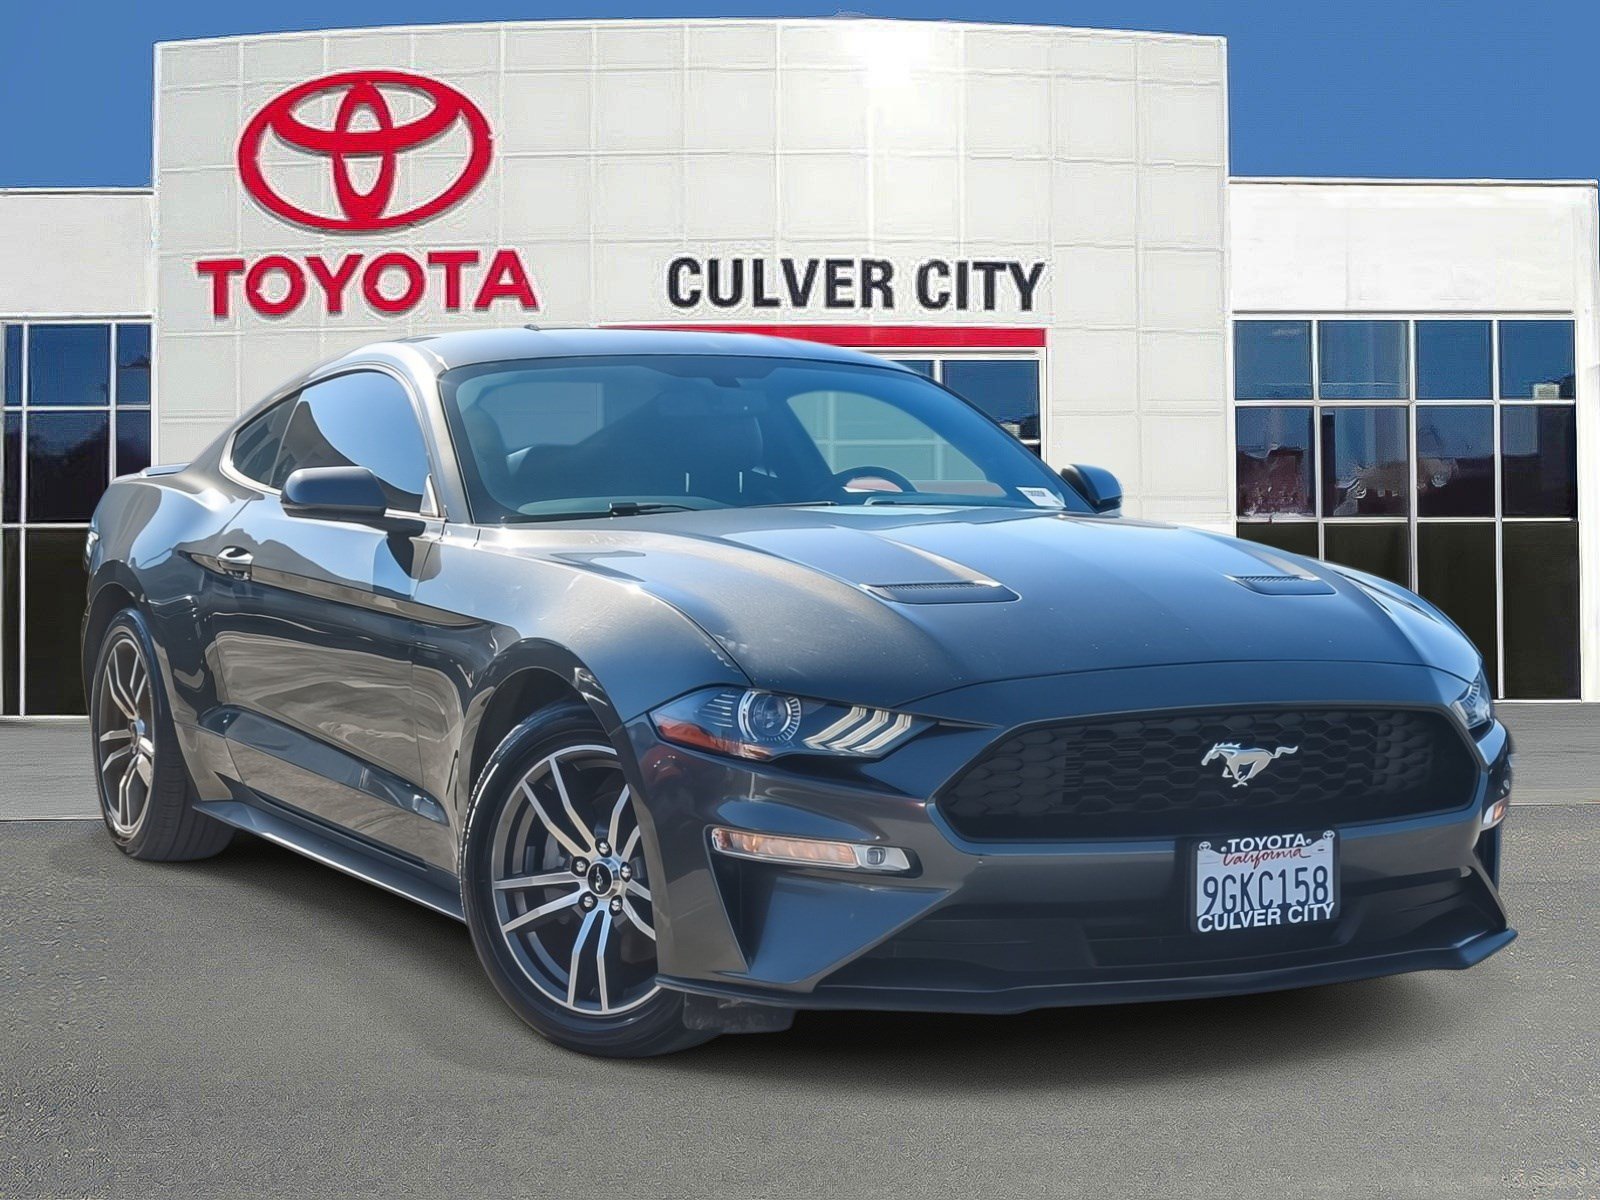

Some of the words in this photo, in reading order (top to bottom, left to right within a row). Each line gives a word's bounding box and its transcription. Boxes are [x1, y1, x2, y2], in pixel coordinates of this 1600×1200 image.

[195, 249, 538, 318] TOYOTA
[668, 257, 895, 309] CULVER
[916, 260, 1045, 311] CITY
[1223, 847, 1311, 869] California
[1227, 833, 1306, 853] TOYOTA
[1203, 865, 1328, 915] 9GKC158
[1197, 909, 1281, 933] CULVER
[1287, 902, 1335, 924] CITY
